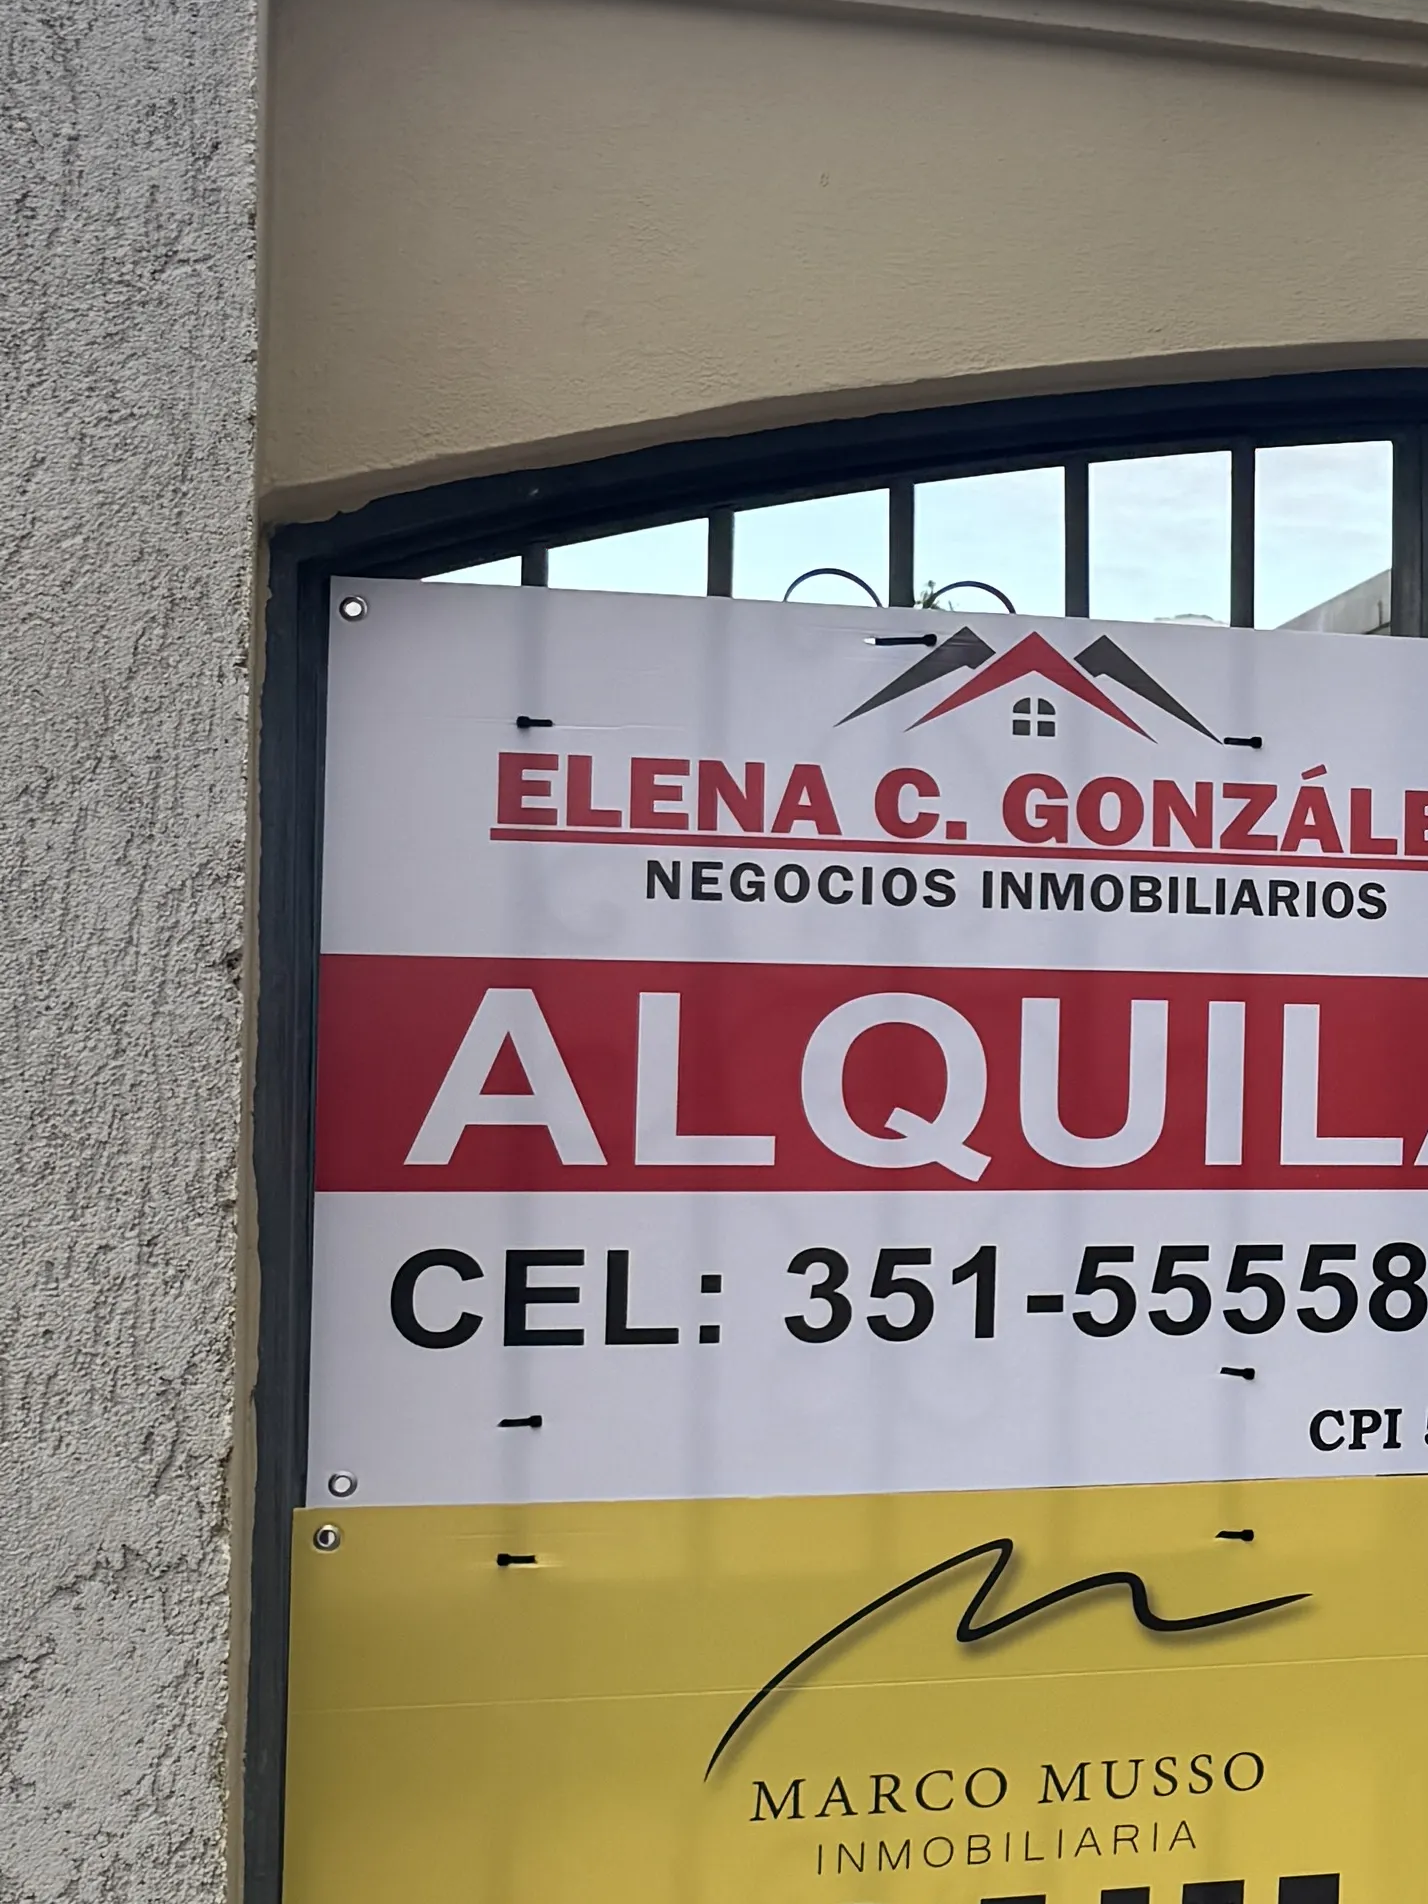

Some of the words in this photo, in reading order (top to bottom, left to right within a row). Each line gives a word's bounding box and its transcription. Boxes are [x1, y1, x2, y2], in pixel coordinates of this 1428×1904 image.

[496, 751, 843, 836] ELENA
[874, 767, 968, 841] C.
[646, 859, 957, 908] NEGOCIOS
[982, 870, 1387, 920] INMOBILIARIOS
[390, 1248, 722, 1350] CEL:
[1309, 1408, 1403, 1452] CPI
[749, 1767, 1008, 1822] MARCO
[1037, 1751, 1265, 1804] MUSSO
[816, 1820, 1197, 1876] INMOBILIARIA
